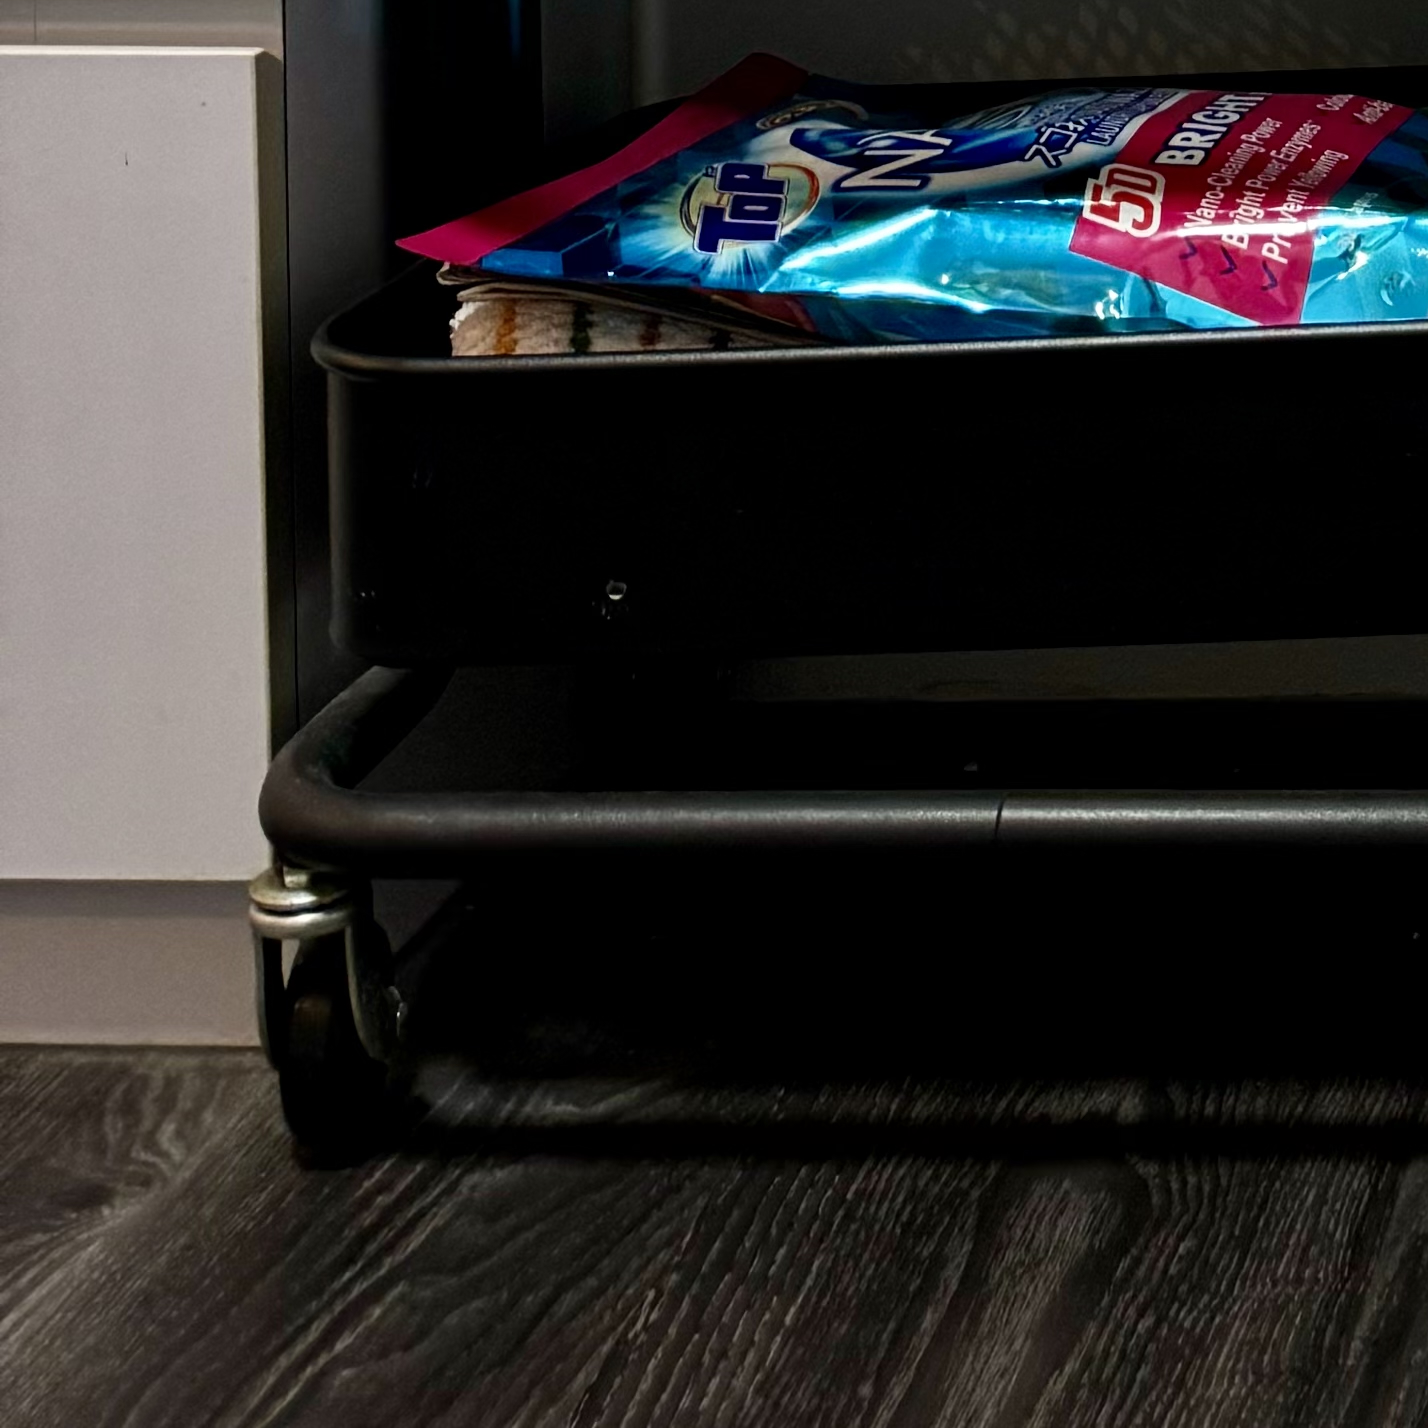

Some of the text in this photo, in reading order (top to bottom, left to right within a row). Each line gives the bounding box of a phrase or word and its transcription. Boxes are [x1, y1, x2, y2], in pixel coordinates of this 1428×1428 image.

[1240, 117, 1283, 145] Power
[693, 162, 789, 254] TOP
[1083, 164, 1166, 237] 5D
[1261, 189, 1310, 264] Prvent
